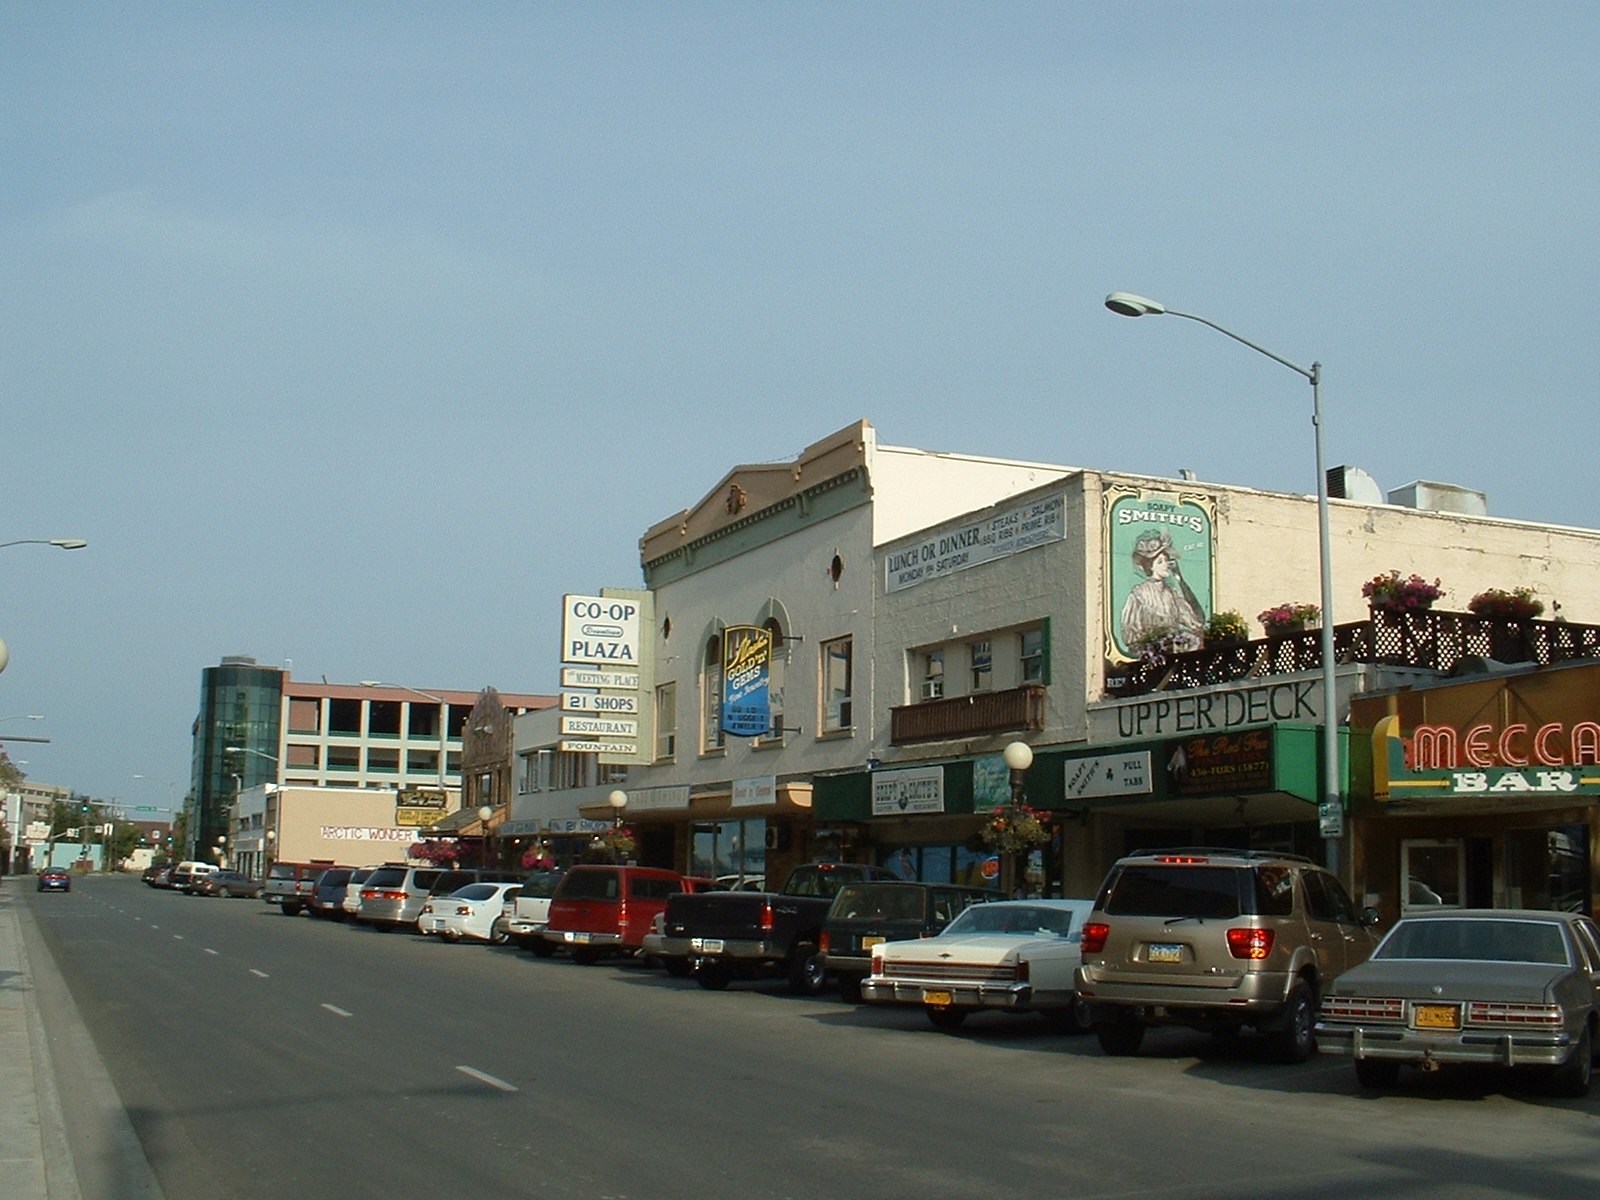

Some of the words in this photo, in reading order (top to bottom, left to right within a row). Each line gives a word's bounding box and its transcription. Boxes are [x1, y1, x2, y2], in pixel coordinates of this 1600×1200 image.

[991, 512, 1019, 531] STEAKS
[1030, 499, 1061, 517] SALMON
[1147, 502, 1176, 512] SOAPY
[1118, 509, 1204, 533] SMITH'S
[888, 548, 919, 573] LUNCH
[921, 542, 936, 561] OR
[939, 527, 981, 557] DINNER
[897, 565, 925, 585] MONDAY
[936, 551, 970, 573] SATURDAY
[573, 601, 636, 621] CO-OP
[571, 640, 633, 660] PLAZA
[727, 656, 756, 681] GOLD
[732, 665, 761, 690] GEMS
[576, 672, 611, 686] MEETING
[613, 674, 639, 688] PLACE
[569, 696, 588, 711] 21
[594, 697, 635, 712] SHOPS
[1117, 696, 1216, 738] UPPER
[1222, 681, 1317, 727] DECK
[568, 720, 634, 734] RESTAURANT
[566, 743, 634, 753] FOUNTAIN
[1412, 720, 1600, 770] MECCA
[1123, 760, 1143, 770] PULL
[1123, 777, 1144, 787] TABS
[1452, 771, 1579, 793] BAR
[321, 826, 363, 839] ARCTIC
[368, 828, 414, 842] WONDER
